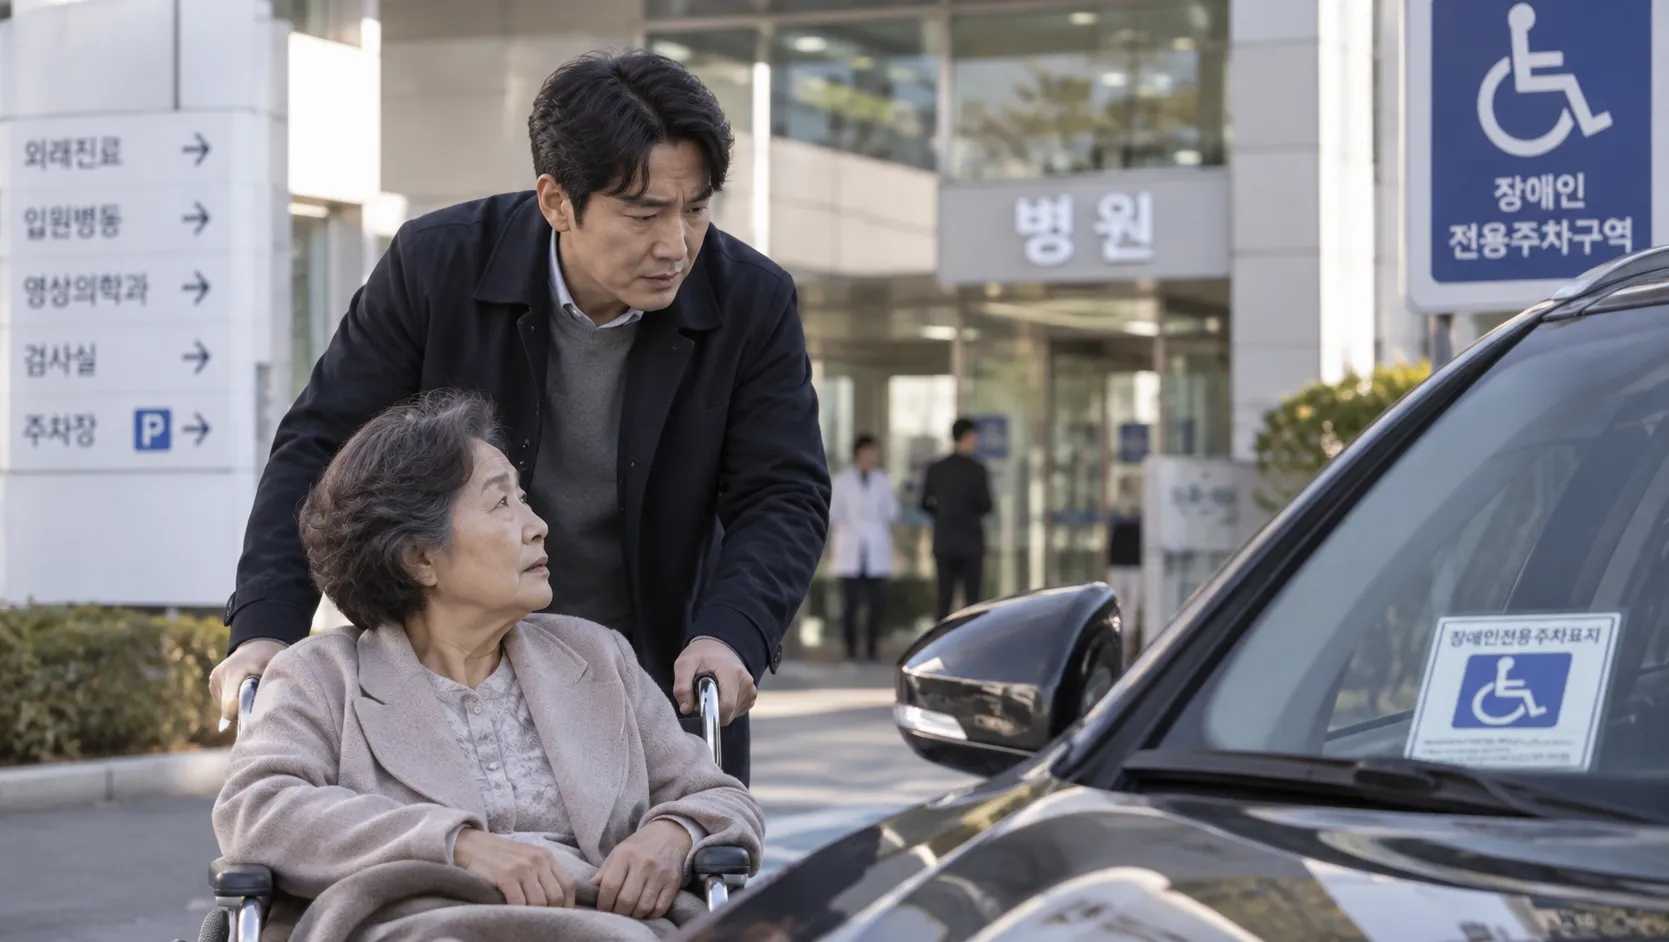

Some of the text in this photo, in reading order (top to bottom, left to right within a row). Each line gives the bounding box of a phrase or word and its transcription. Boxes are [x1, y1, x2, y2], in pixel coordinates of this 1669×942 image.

[24, 136, 121, 170] 외래진료
[1493, 172, 1586, 213] 장애인
[24, 205, 121, 241] 입원병동
[1448, 216, 1634, 261] 전용주차구역
[23, 273, 149, 309] 영상의학과
[24, 344, 97, 378] 검사실
[23, 413, 165, 448] 주차장 P
